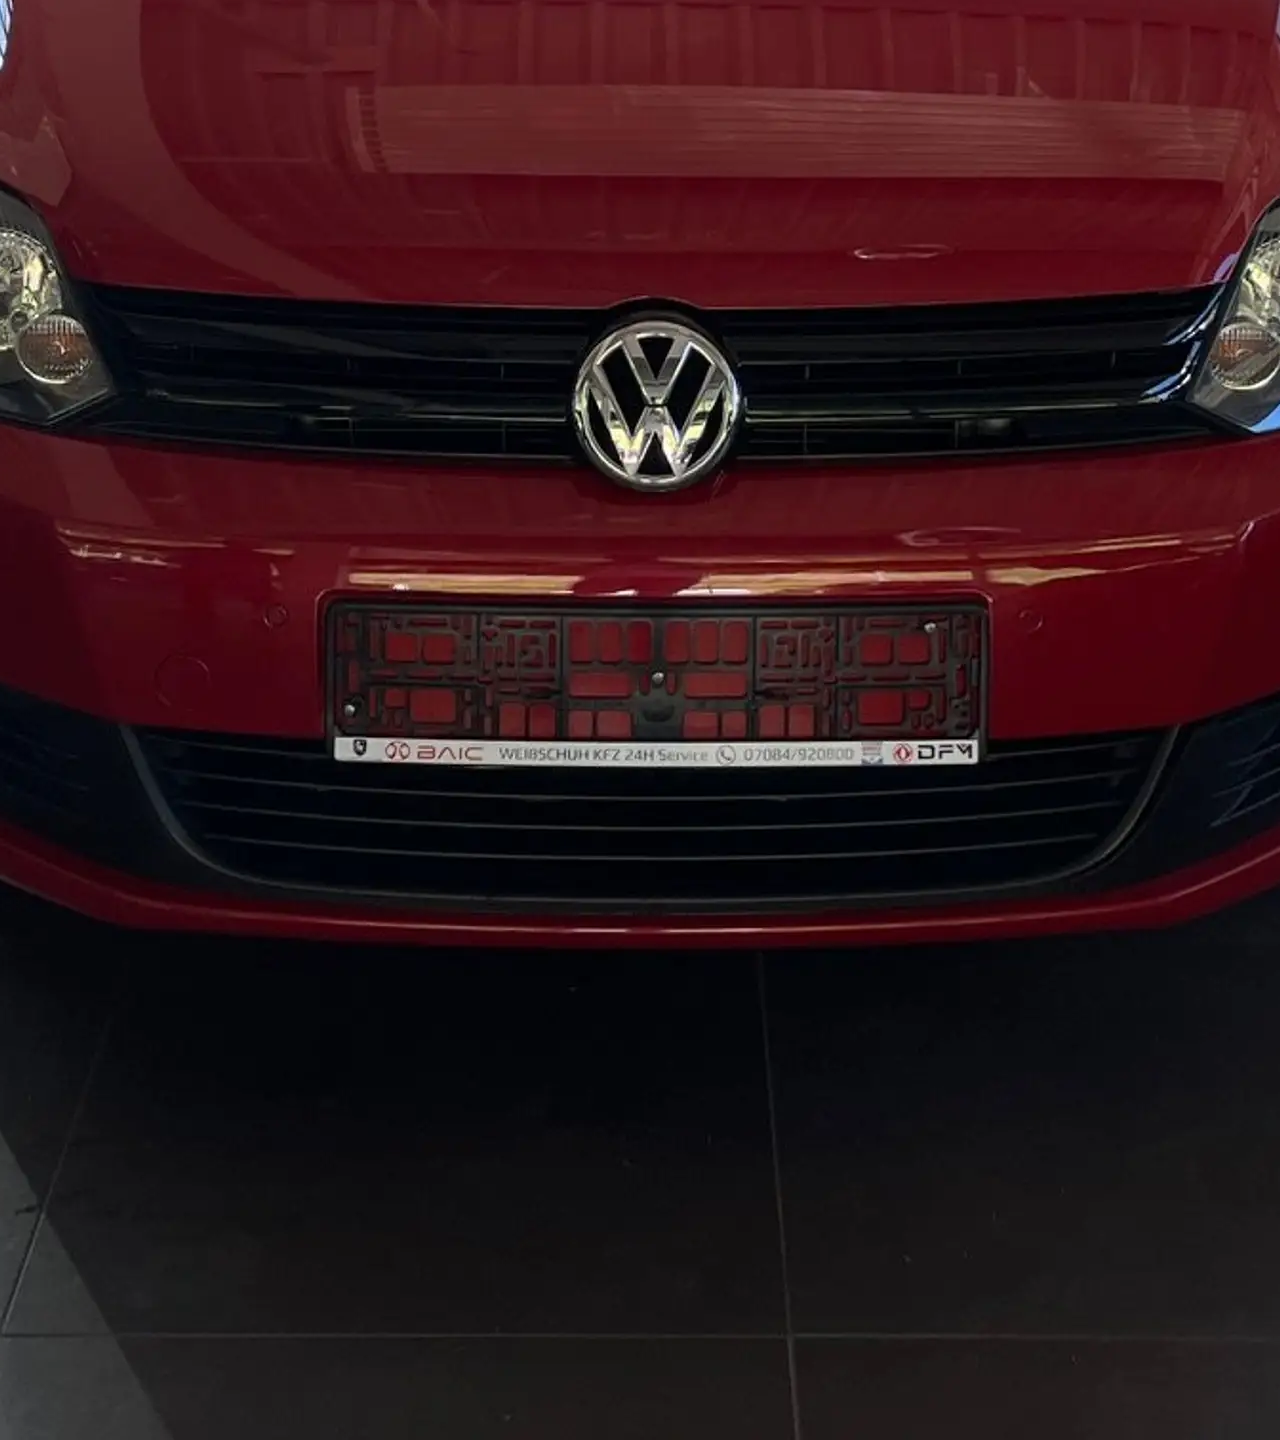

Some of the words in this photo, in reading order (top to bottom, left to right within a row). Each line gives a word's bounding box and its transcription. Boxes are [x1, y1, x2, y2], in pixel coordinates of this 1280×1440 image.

[576, 323, 740, 489] VW
[416, 745, 484, 762] BAIC
[592, 747, 621, 762] KFZ
[625, 748, 655, 763] 24H
[659, 748, 709, 763] Service
[918, 744, 973, 760] DFM
